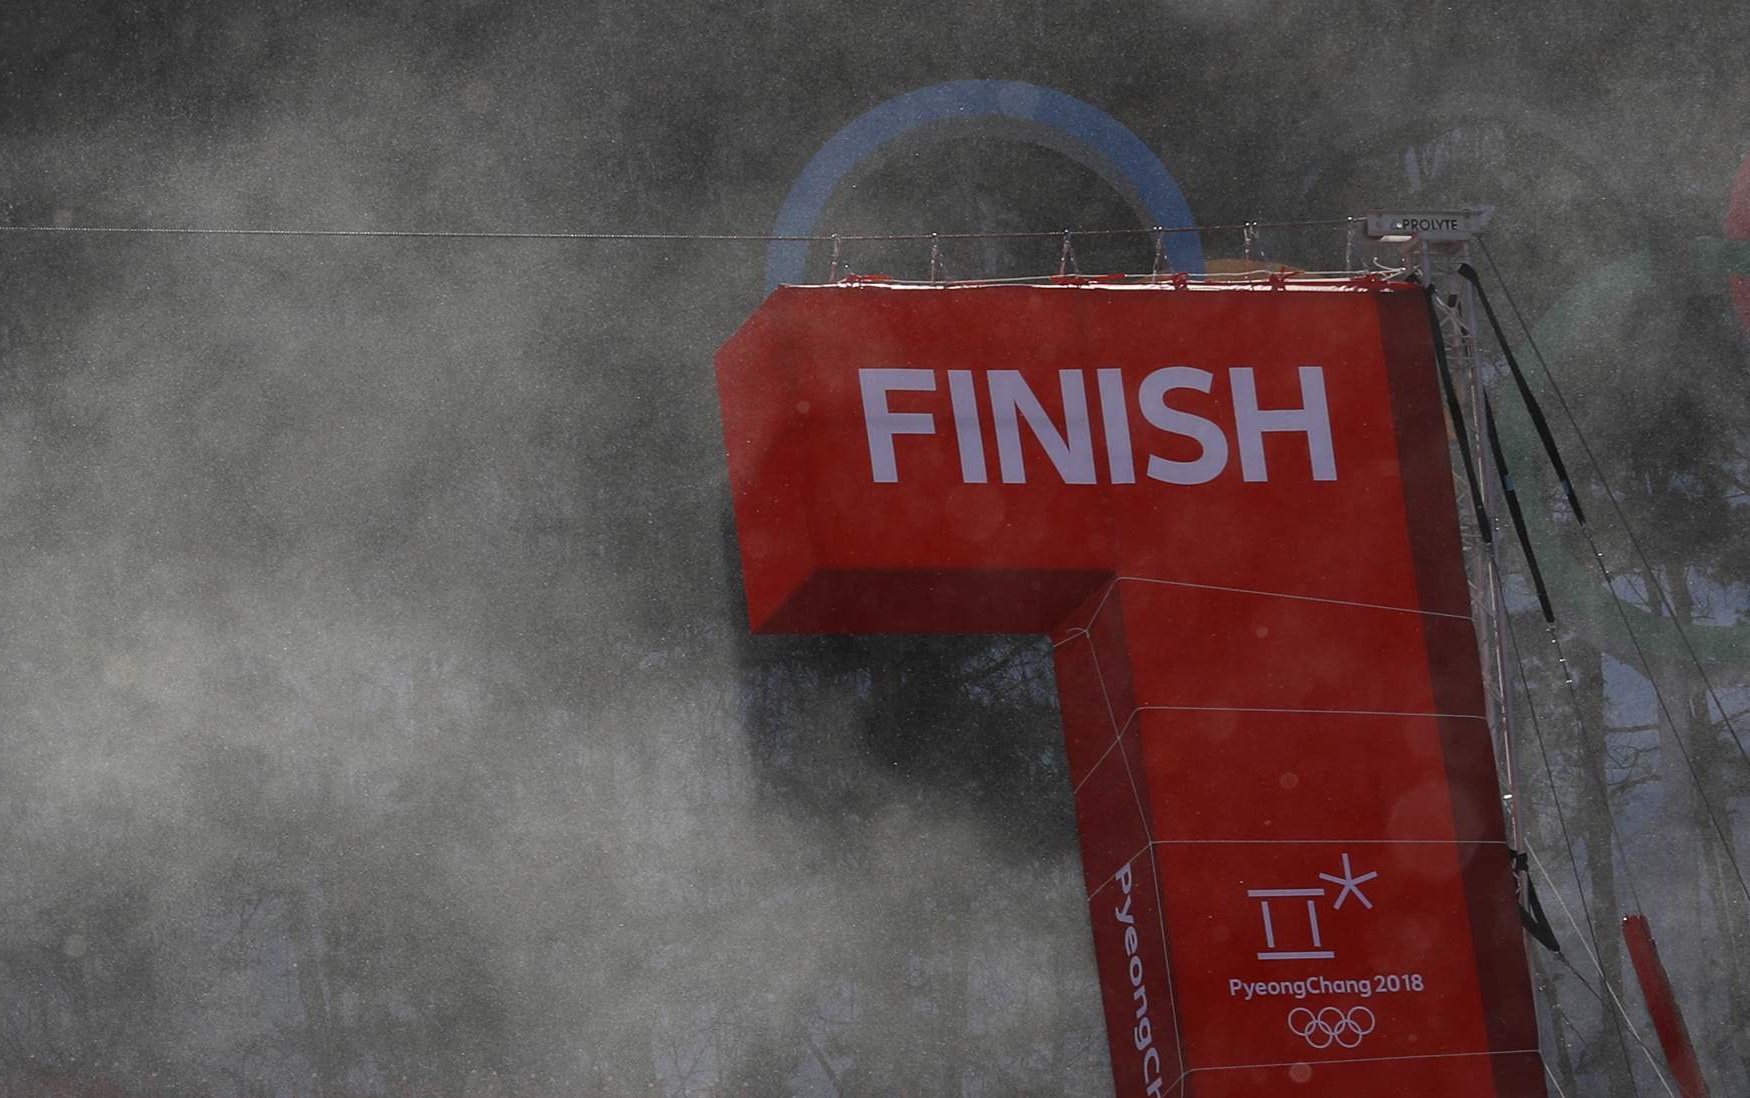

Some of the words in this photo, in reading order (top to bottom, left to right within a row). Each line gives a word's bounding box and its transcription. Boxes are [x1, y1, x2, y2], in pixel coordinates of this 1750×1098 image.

[1402, 219, 1459, 231] PROLYTE
[858, 366, 1338, 485] FINISH
[1229, 976, 1372, 1000] PyeongChang
[1373, 974, 1425, 993] 2018
